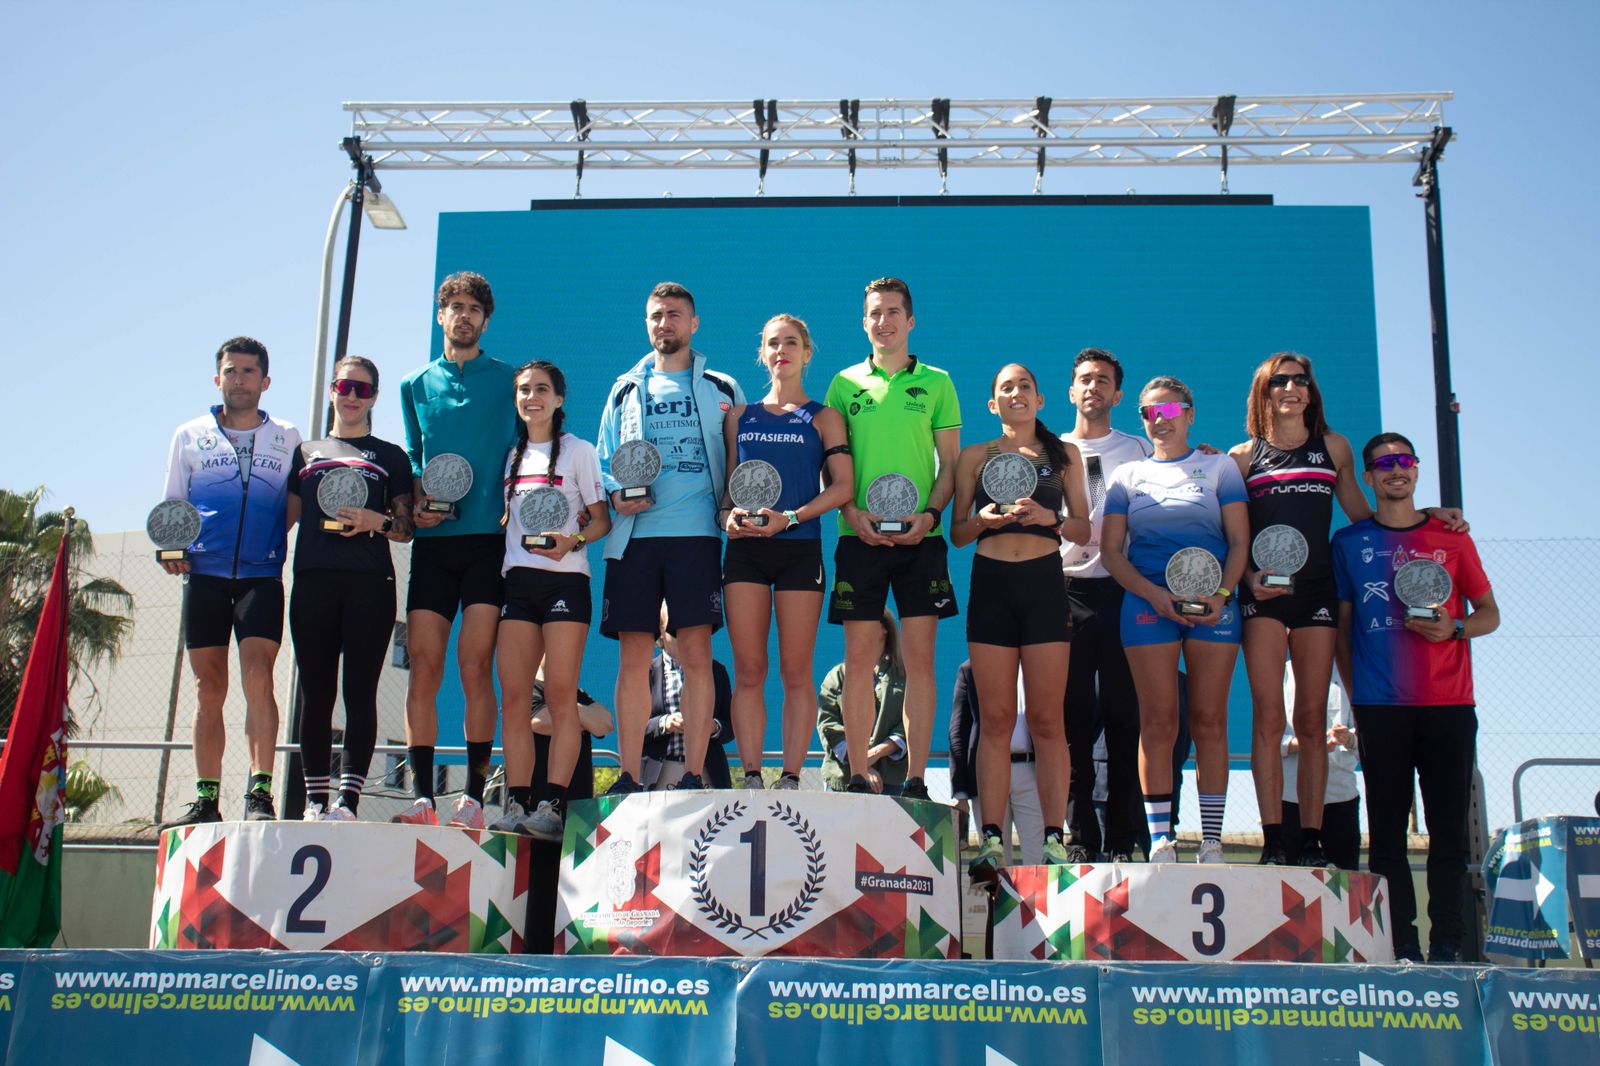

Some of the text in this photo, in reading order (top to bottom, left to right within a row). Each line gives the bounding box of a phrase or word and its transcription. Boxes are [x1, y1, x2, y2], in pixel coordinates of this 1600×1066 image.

[645, 395, 699, 418] erj
[650, 420, 700, 430] ATLETISMO
[738, 432, 804, 443] TROTASIERRA
[740, 820, 767, 917] 1
[285, 844, 332, 934] 2
[861, 876, 931, 892] #Granada2031
[1191, 883, 1226, 956] 3
[55, 969, 358, 993] www.mpmarcelino.es
[400, 973, 710, 998] www.mpmarcelino.es
[768, 979, 1088, 1004] www.mpmarcelino.es
[51, 989, 356, 1014] www.mpmarcelino.es
[398, 993, 709, 1018] www.mpmarcelino.es
[1131, 983, 1460, 1009] www.mpmarcelino.es
[768, 999, 1088, 1025] www.mpmarcelino.es
[1133, 1006, 1463, 1031] www.mpmarcelino.es
